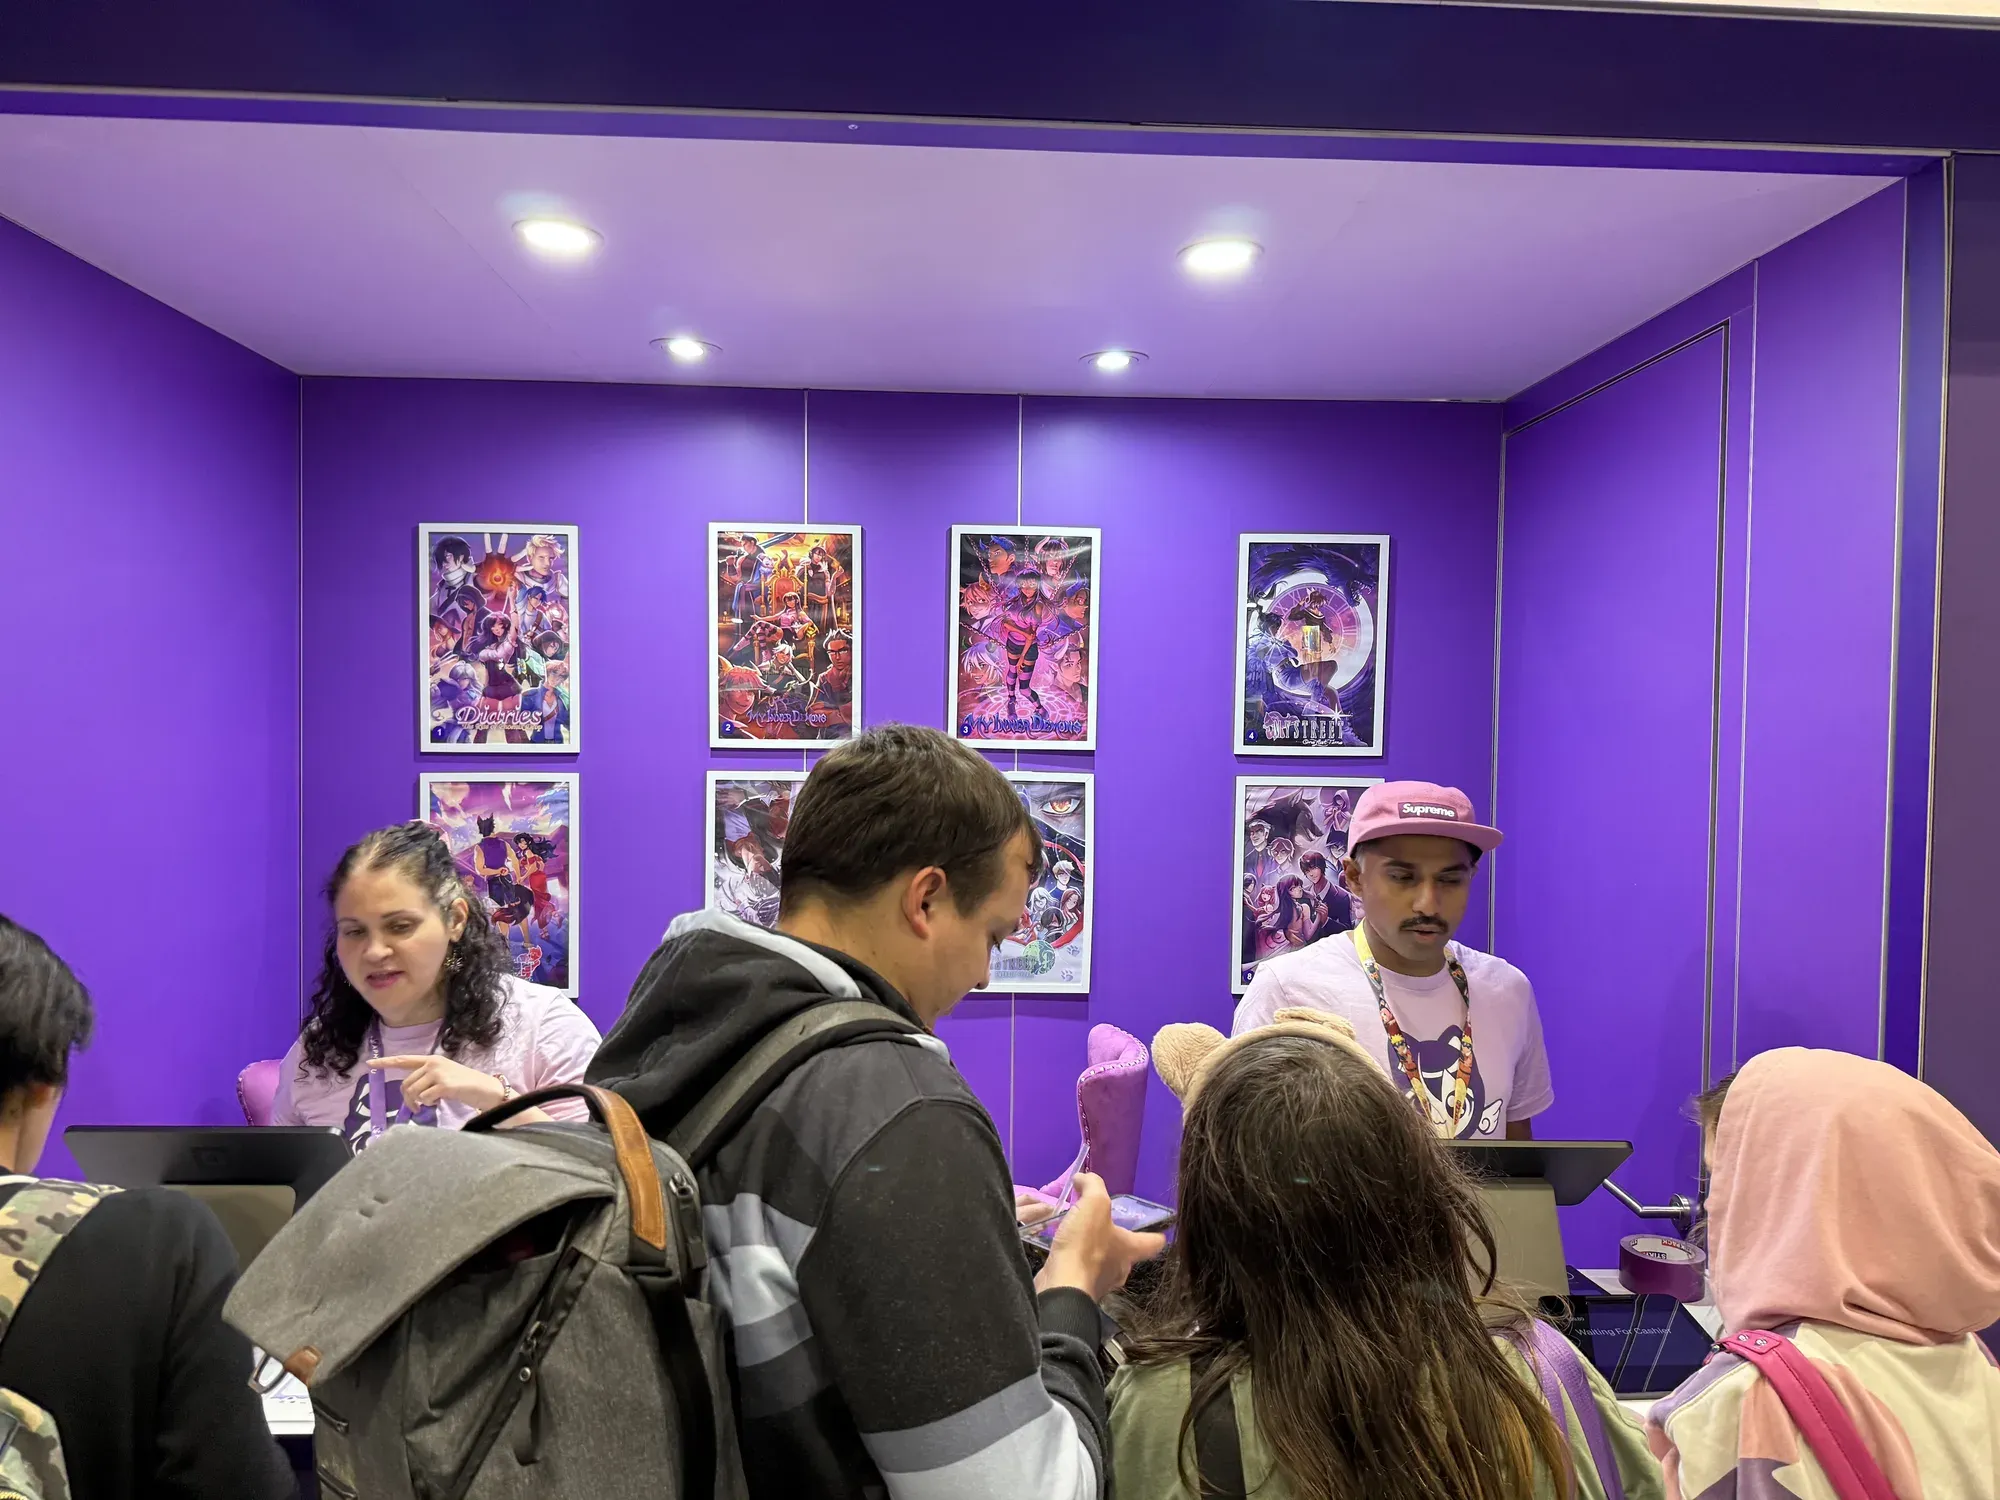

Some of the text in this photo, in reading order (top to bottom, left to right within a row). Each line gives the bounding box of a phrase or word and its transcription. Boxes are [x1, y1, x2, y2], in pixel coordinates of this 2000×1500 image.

[456, 705, 543, 725] Diaries
[725, 723, 731, 731] 2
[1031, 713, 1083, 739] DEMONS
[437, 728, 442, 736] 1
[1248, 732, 1254, 740] 4
[1402, 803, 1455, 817] Supreme
[1247, 972, 1252, 980] 8
[1574, 1327, 1672, 1336] Waiting For Cashier
